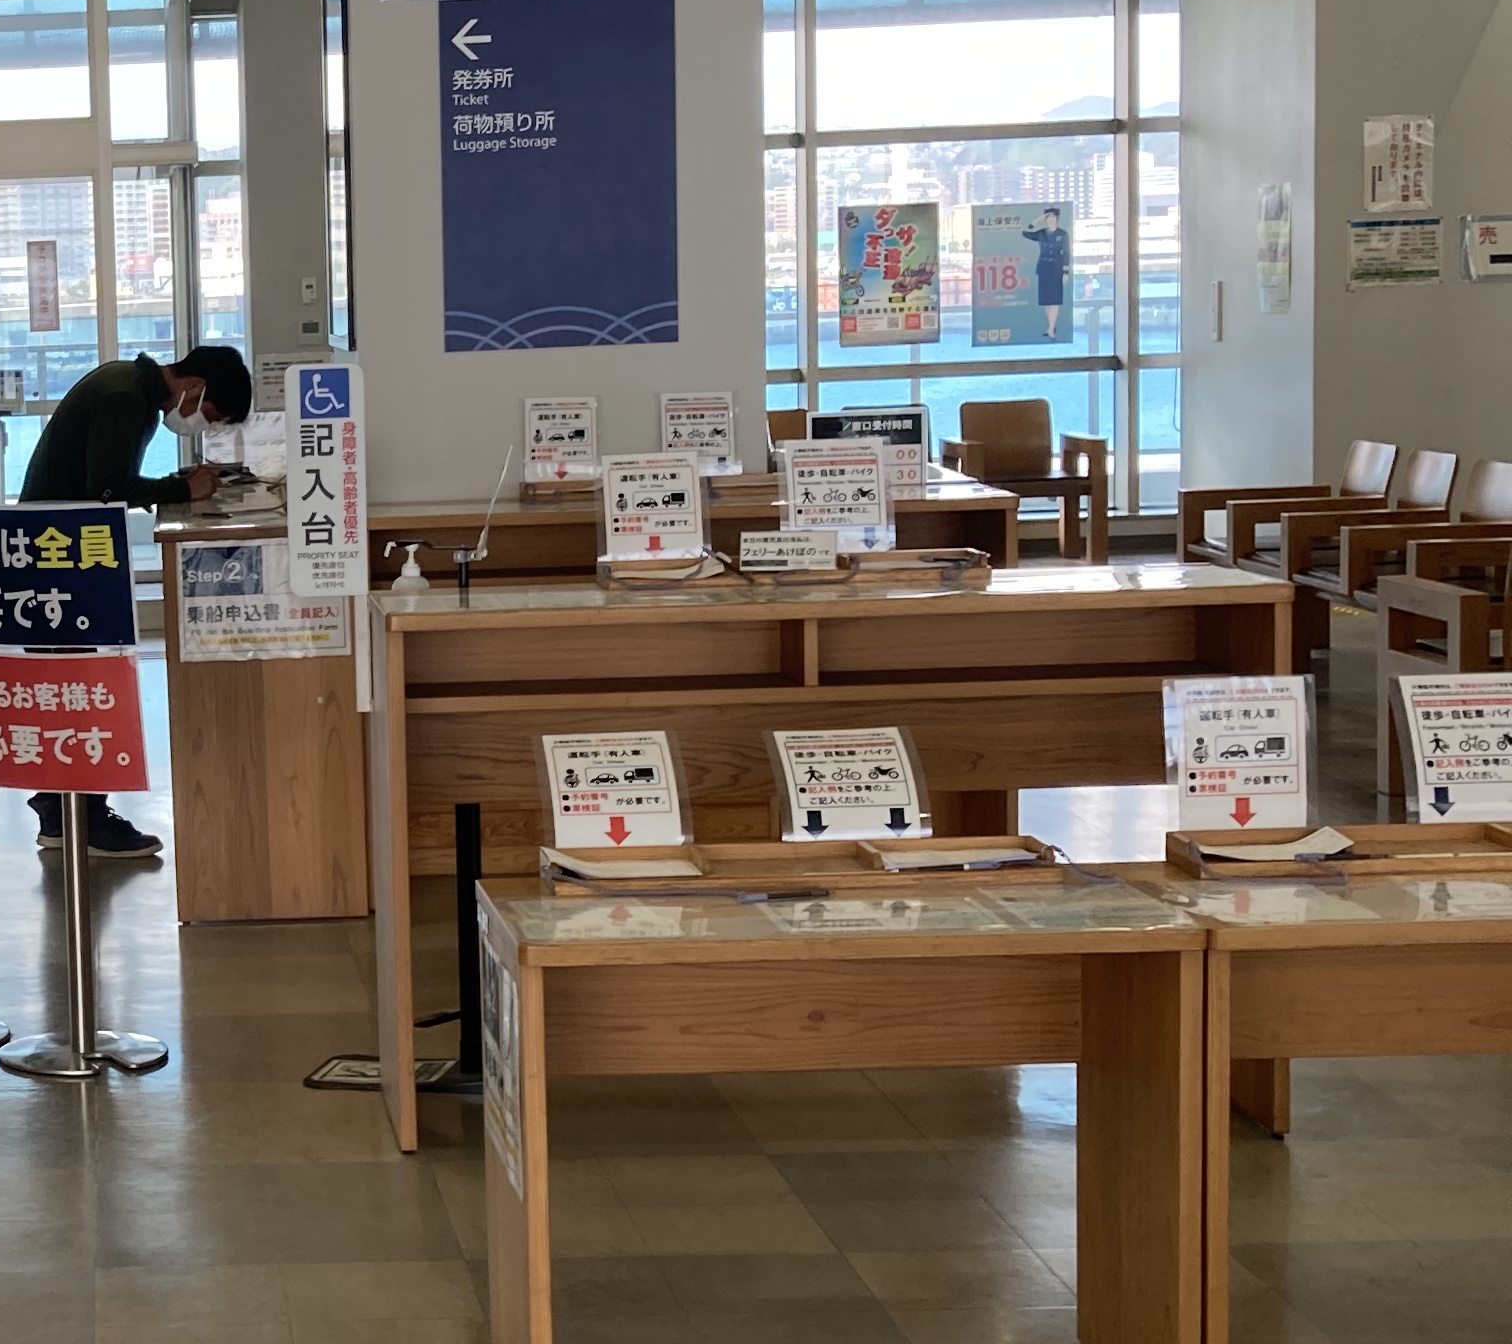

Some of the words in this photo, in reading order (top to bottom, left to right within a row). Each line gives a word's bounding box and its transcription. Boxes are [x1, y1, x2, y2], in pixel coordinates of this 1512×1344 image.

[452, 67, 514, 90] 発券所
[452, 92, 489, 106] Ticket
[452, 111, 556, 136] 荷物預り所
[453, 137, 507, 153] Luggage
[509, 134, 558, 150] Storage
[300, 423, 335, 546] 記入台
[297, 551, 336, 560] PRIORITY
[338, 550, 360, 559] SEAT
[187, 603, 281, 624] 乗船申込書
